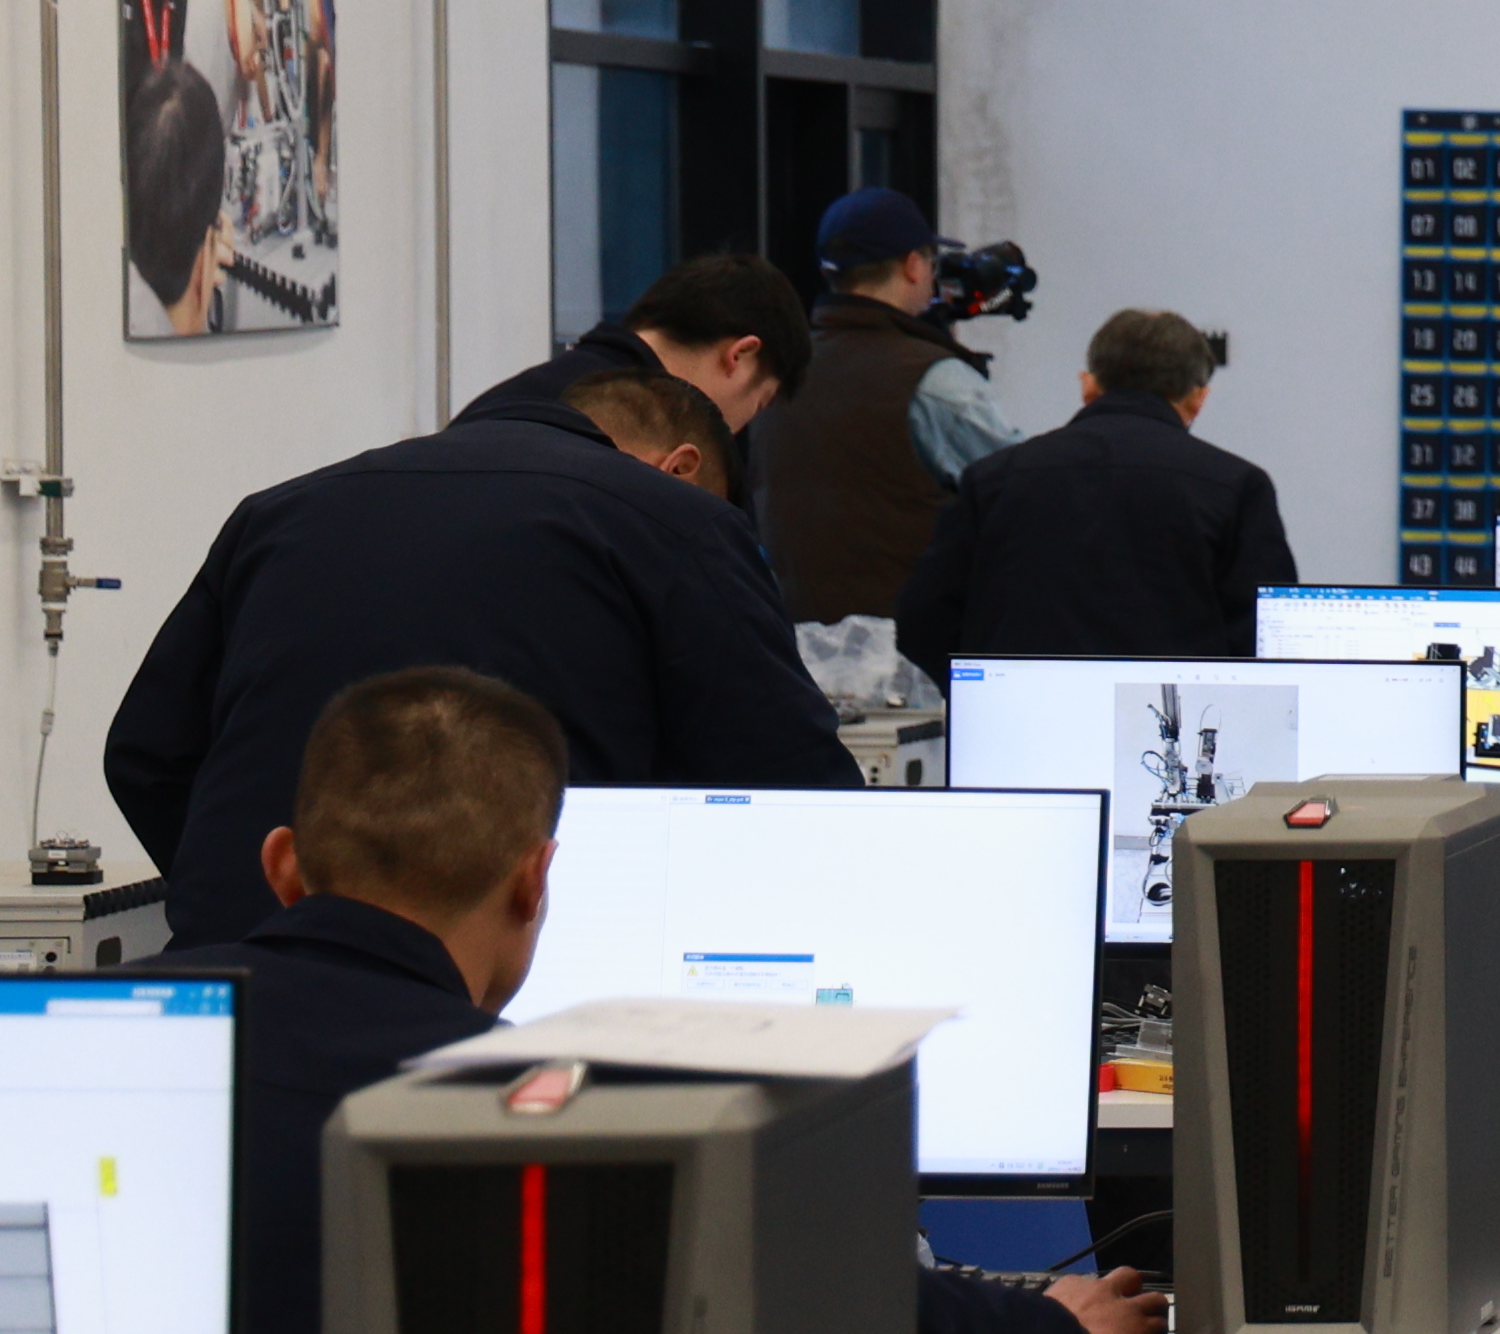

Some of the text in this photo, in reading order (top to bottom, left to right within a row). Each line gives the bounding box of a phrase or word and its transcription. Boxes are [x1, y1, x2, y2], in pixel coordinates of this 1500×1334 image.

[1383, 945, 1417, 1278] BETTER GAMING EXPERIENCE
